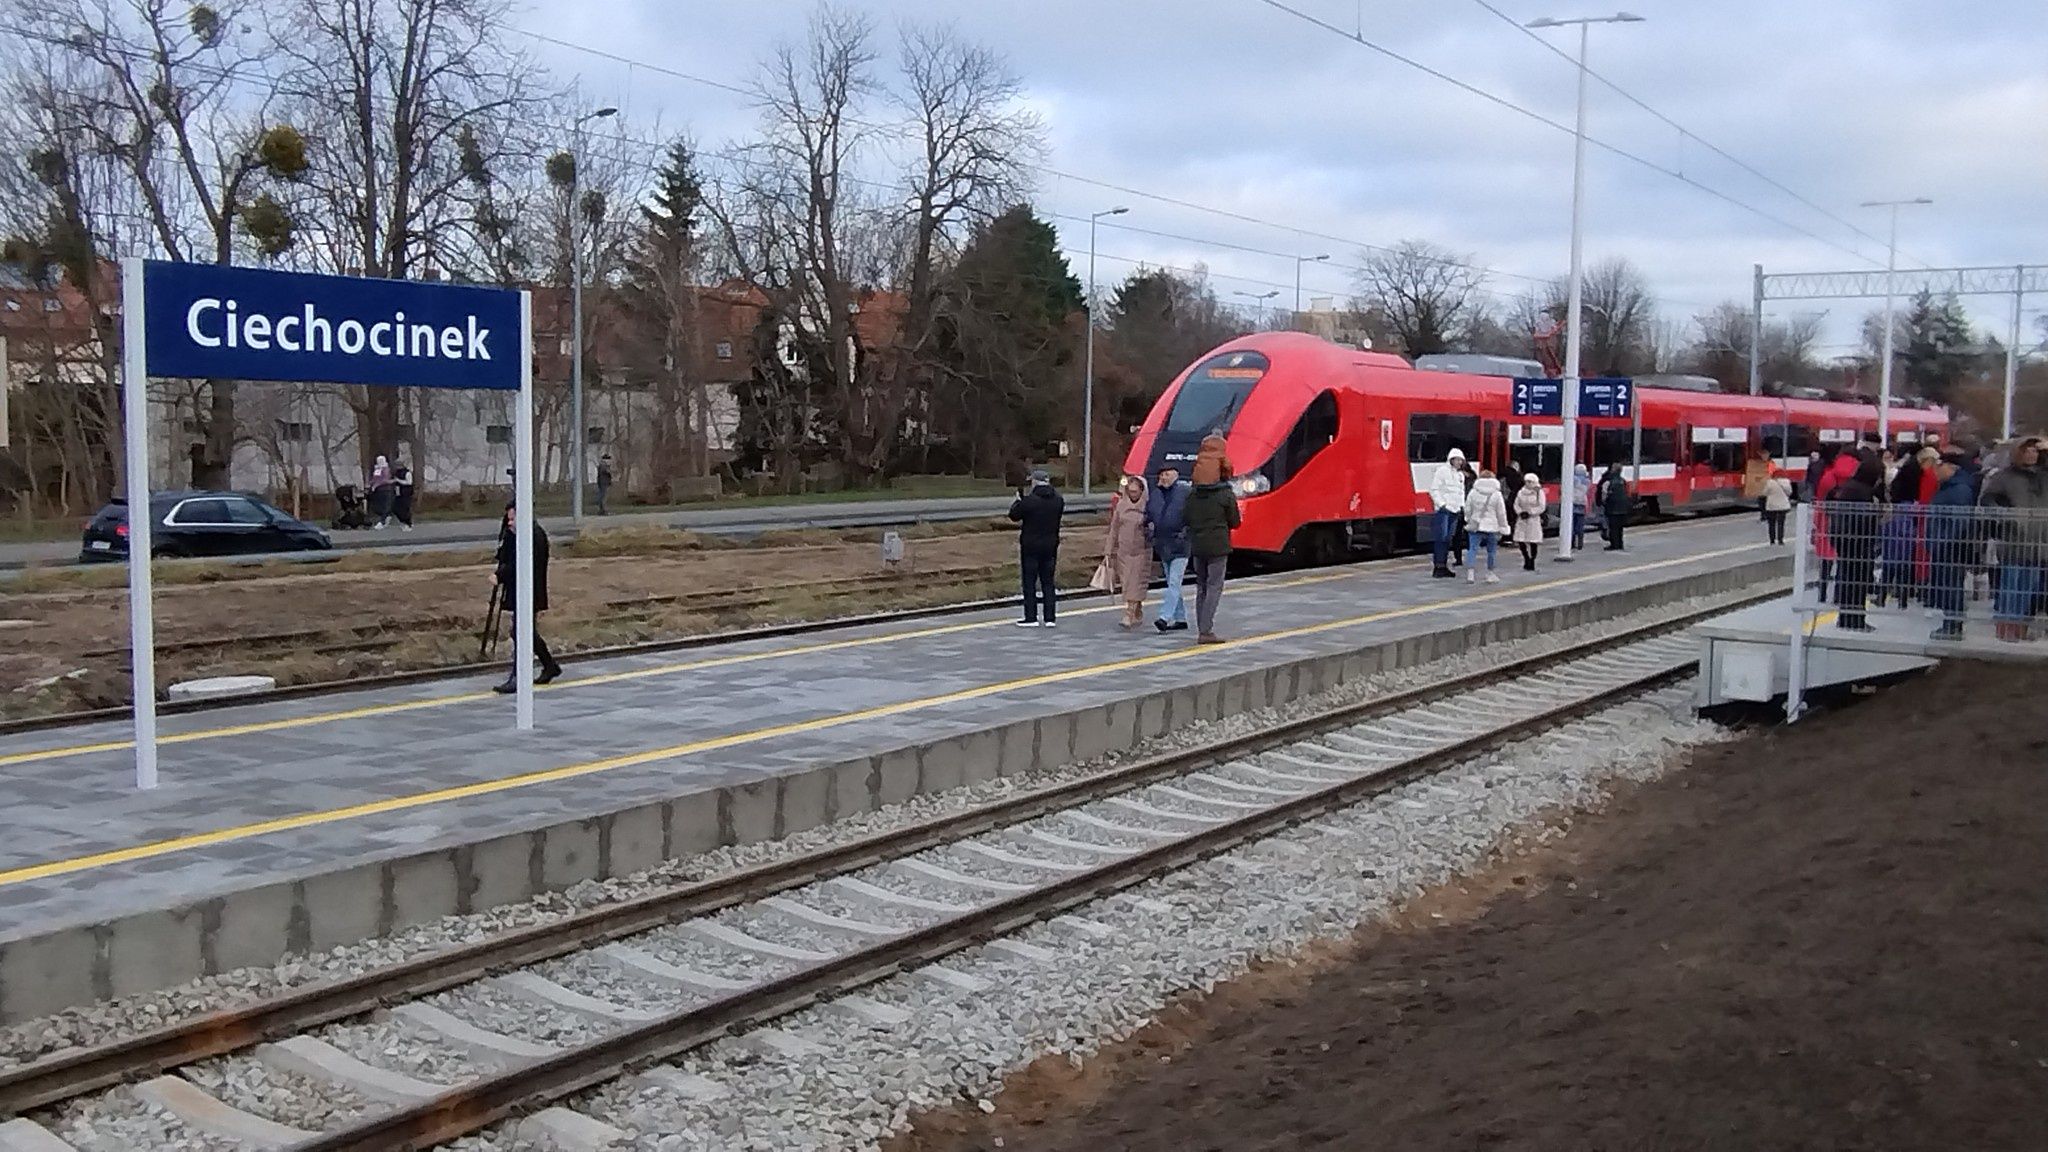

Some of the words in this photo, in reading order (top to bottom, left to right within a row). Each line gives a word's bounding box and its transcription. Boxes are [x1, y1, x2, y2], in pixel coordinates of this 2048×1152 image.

[187, 298, 491, 360] Ciechocinek
[1518, 384, 1527, 398] 2
[1617, 385, 1626, 399] 2
[1619, 404, 1625, 415] 1
